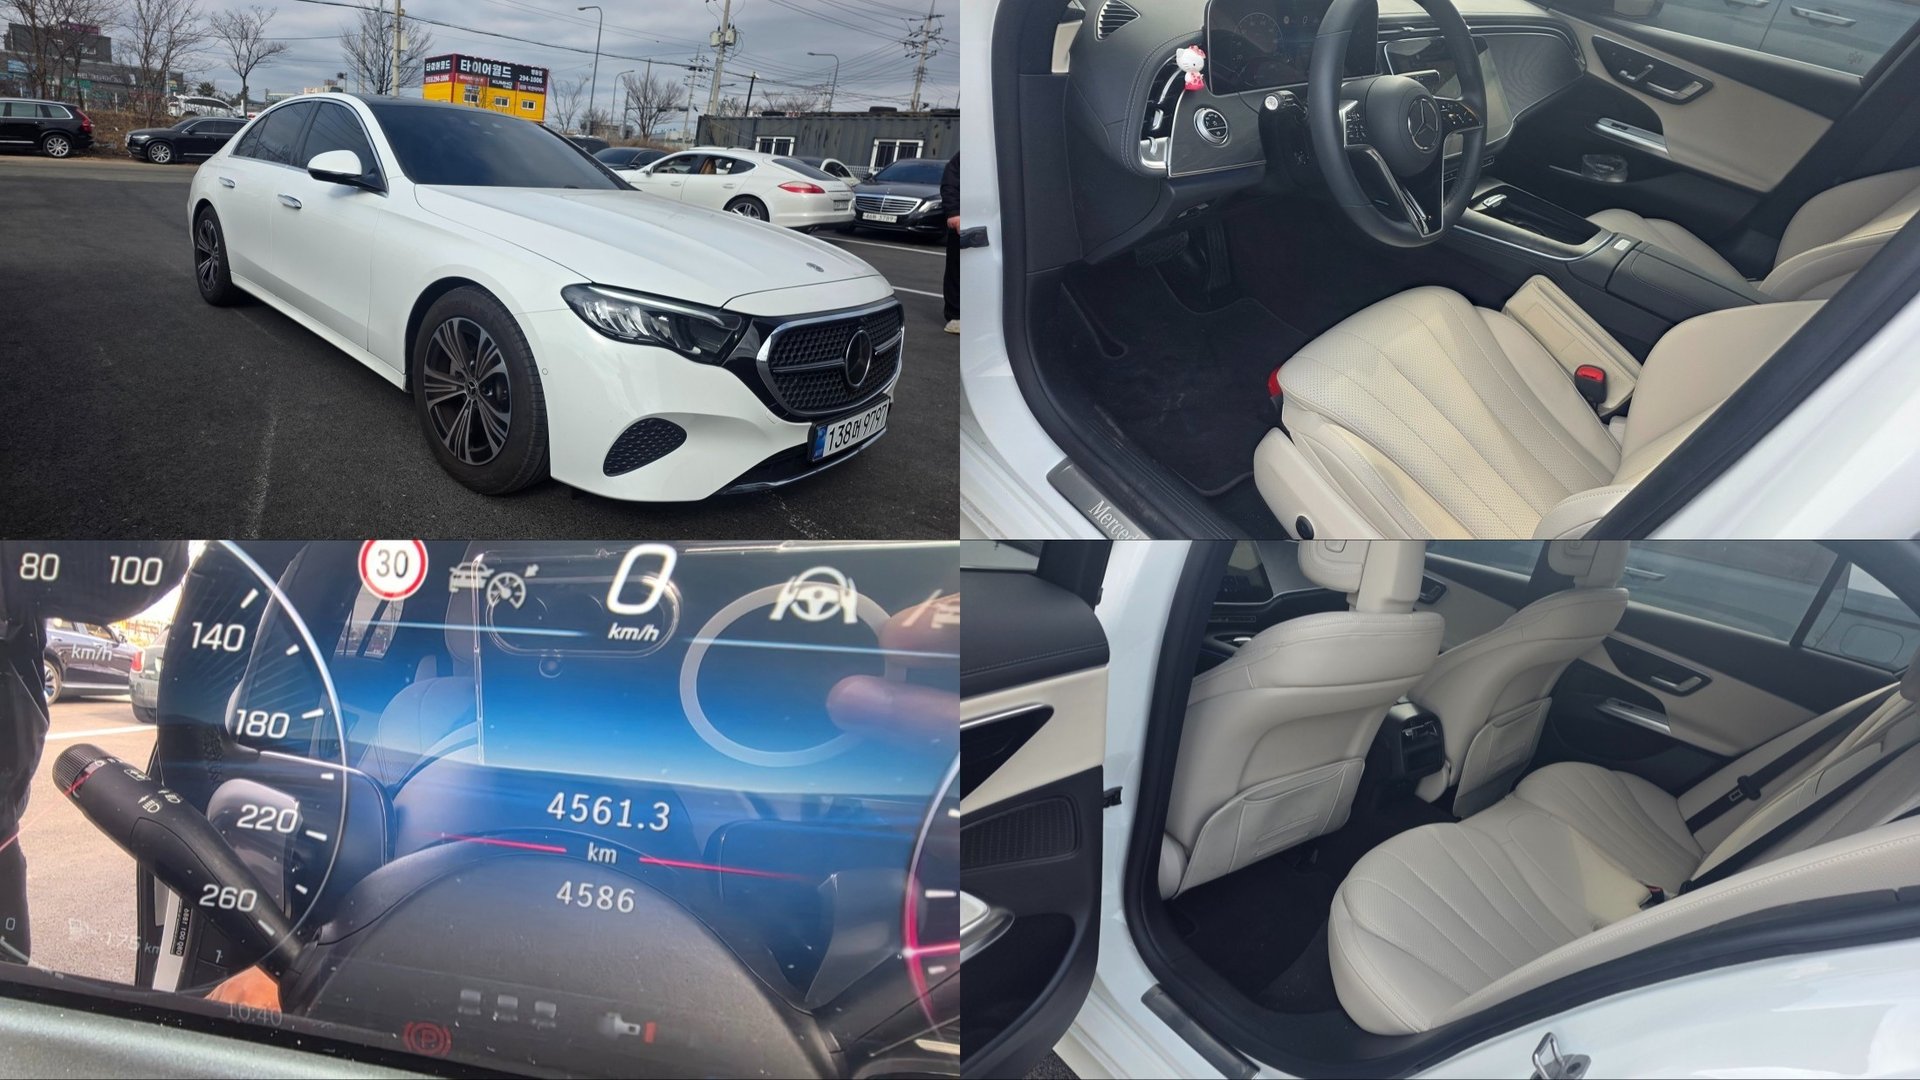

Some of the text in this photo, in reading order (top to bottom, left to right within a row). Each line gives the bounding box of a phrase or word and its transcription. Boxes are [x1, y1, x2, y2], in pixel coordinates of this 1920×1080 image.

[460, 59, 512, 78] 타이어월드
[863, 404, 888, 435] 9797
[19, 552, 60, 581] 80
[110, 555, 163, 586] 100
[376, 549, 409, 578] 30
[606, 543, 678, 615] 0
[192, 621, 246, 652] 140
[608, 622, 660, 642] km/h
[71, 643, 113, 662] km/h
[235, 709, 290, 739] 180
[236, 804, 298, 833] 220
[546, 792, 670, 831] 4561.3
[587, 842, 617, 864] km
[199, 883, 258, 912] 260
[556, 880, 636, 913] 4586
[5, 917, 16, 931] 0
